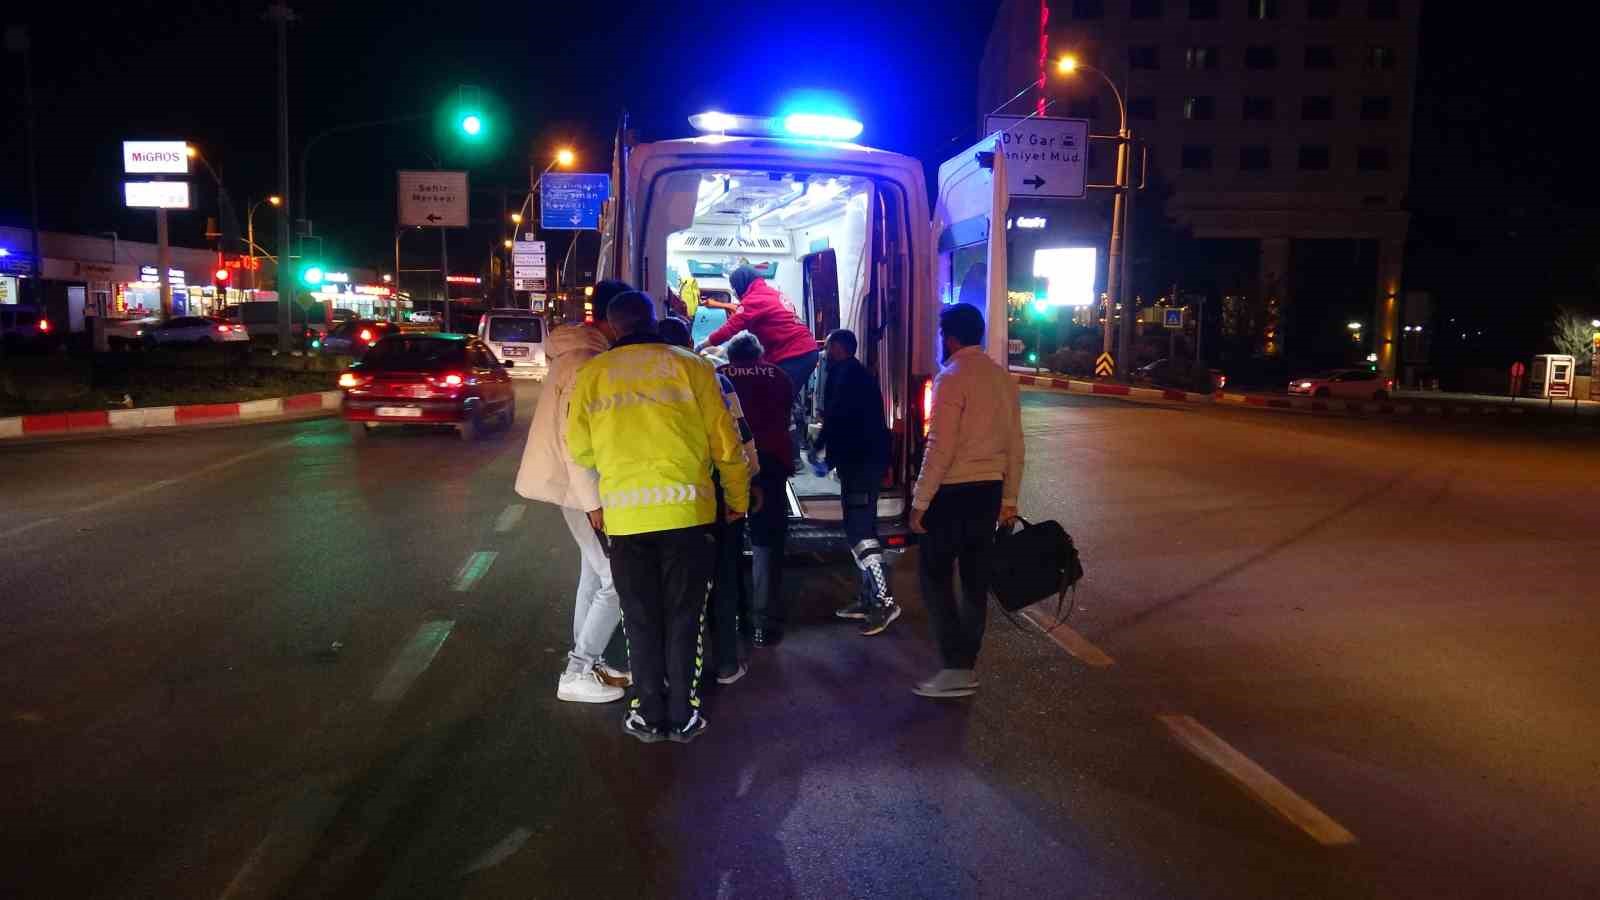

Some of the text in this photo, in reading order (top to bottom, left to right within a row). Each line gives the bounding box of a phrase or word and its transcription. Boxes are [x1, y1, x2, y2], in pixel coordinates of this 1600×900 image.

[1003, 132, 1055, 146] DY Gar
[1006, 151, 1046, 162] niyet
